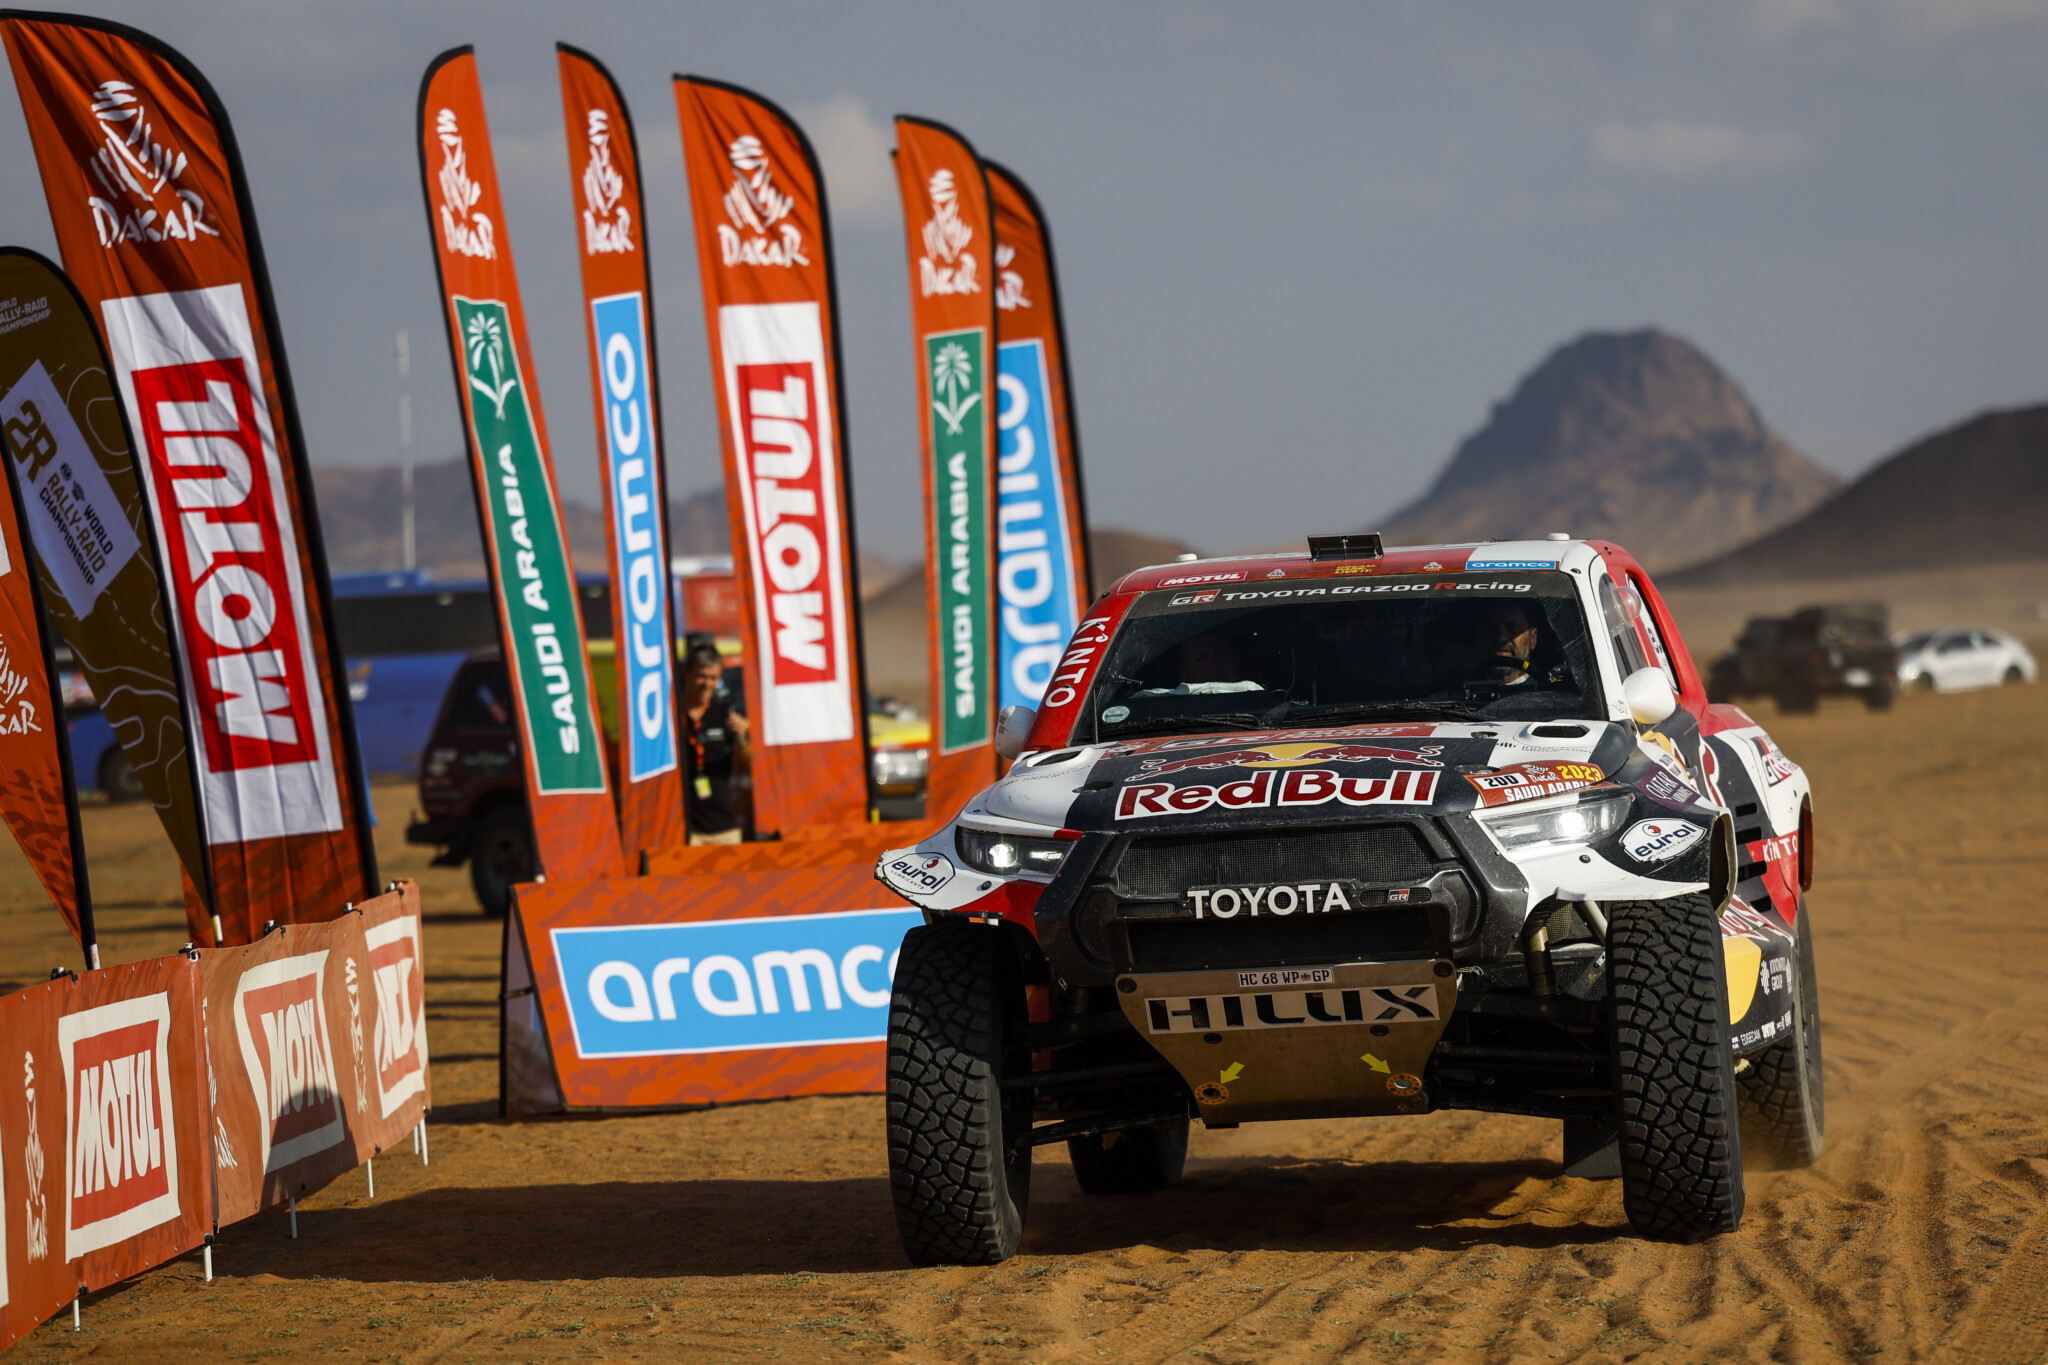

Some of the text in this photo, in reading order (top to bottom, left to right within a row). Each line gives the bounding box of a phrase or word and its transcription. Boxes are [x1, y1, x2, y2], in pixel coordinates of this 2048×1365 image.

[88, 189, 220, 248] DAKAR
[441, 205, 497, 260] DAKAR
[583, 205, 635, 256] DAKAR
[718, 224, 810, 268] DAKAR
[919, 252, 981, 298] DAKAR
[0, 296, 18, 312] ORLD
[0, 296, 49, 325] ALLY-RAID
[0, 308, 52, 336] HAMPIONSHIP
[39, 487, 96, 586] CHAMPIONSHIP
[47, 473, 106, 574] RALLY-RAID
[83, 504, 114, 556] WORLD
[605, 332, 664, 740] aramco
[748, 375, 829, 671] MOTUL
[998, 373, 1063, 701] aramco
[155, 379, 300, 745] MOTUL
[1163, 572, 1242, 587] MOTUL
[498, 443, 581, 755] SAUDI ARABIA
[947, 451, 976, 719] SAUDI ARABIA
[1171, 581, 1532, 606] GR TOYOTA GAZOO Racing
[1045, 616, 1112, 708] KINTO
[0, 700, 42, 736] KAR
[1115, 770, 1277, 820] Red
[1278, 770, 1441, 806] Bull
[1484, 771, 1560, 788] 200 DAKAR
[1503, 783, 1546, 801] SAUDI
[1556, 765, 1603, 782] 2023
[1645, 771, 1679, 801] QATAR
[1635, 823, 1697, 858] eurol
[1762, 835, 1798, 862] KINTO
[890, 870, 925, 891] LUBRICANTS
[891, 860, 947, 890] eurol
[1187, 882, 1351, 919] TOYOTA
[588, 944, 901, 1023] aramc
[1239, 969, 1330, 986] HC 68 WP GP
[1149, 986, 1438, 1031] HILUX
[74, 1049, 162, 1199] MOTUL
